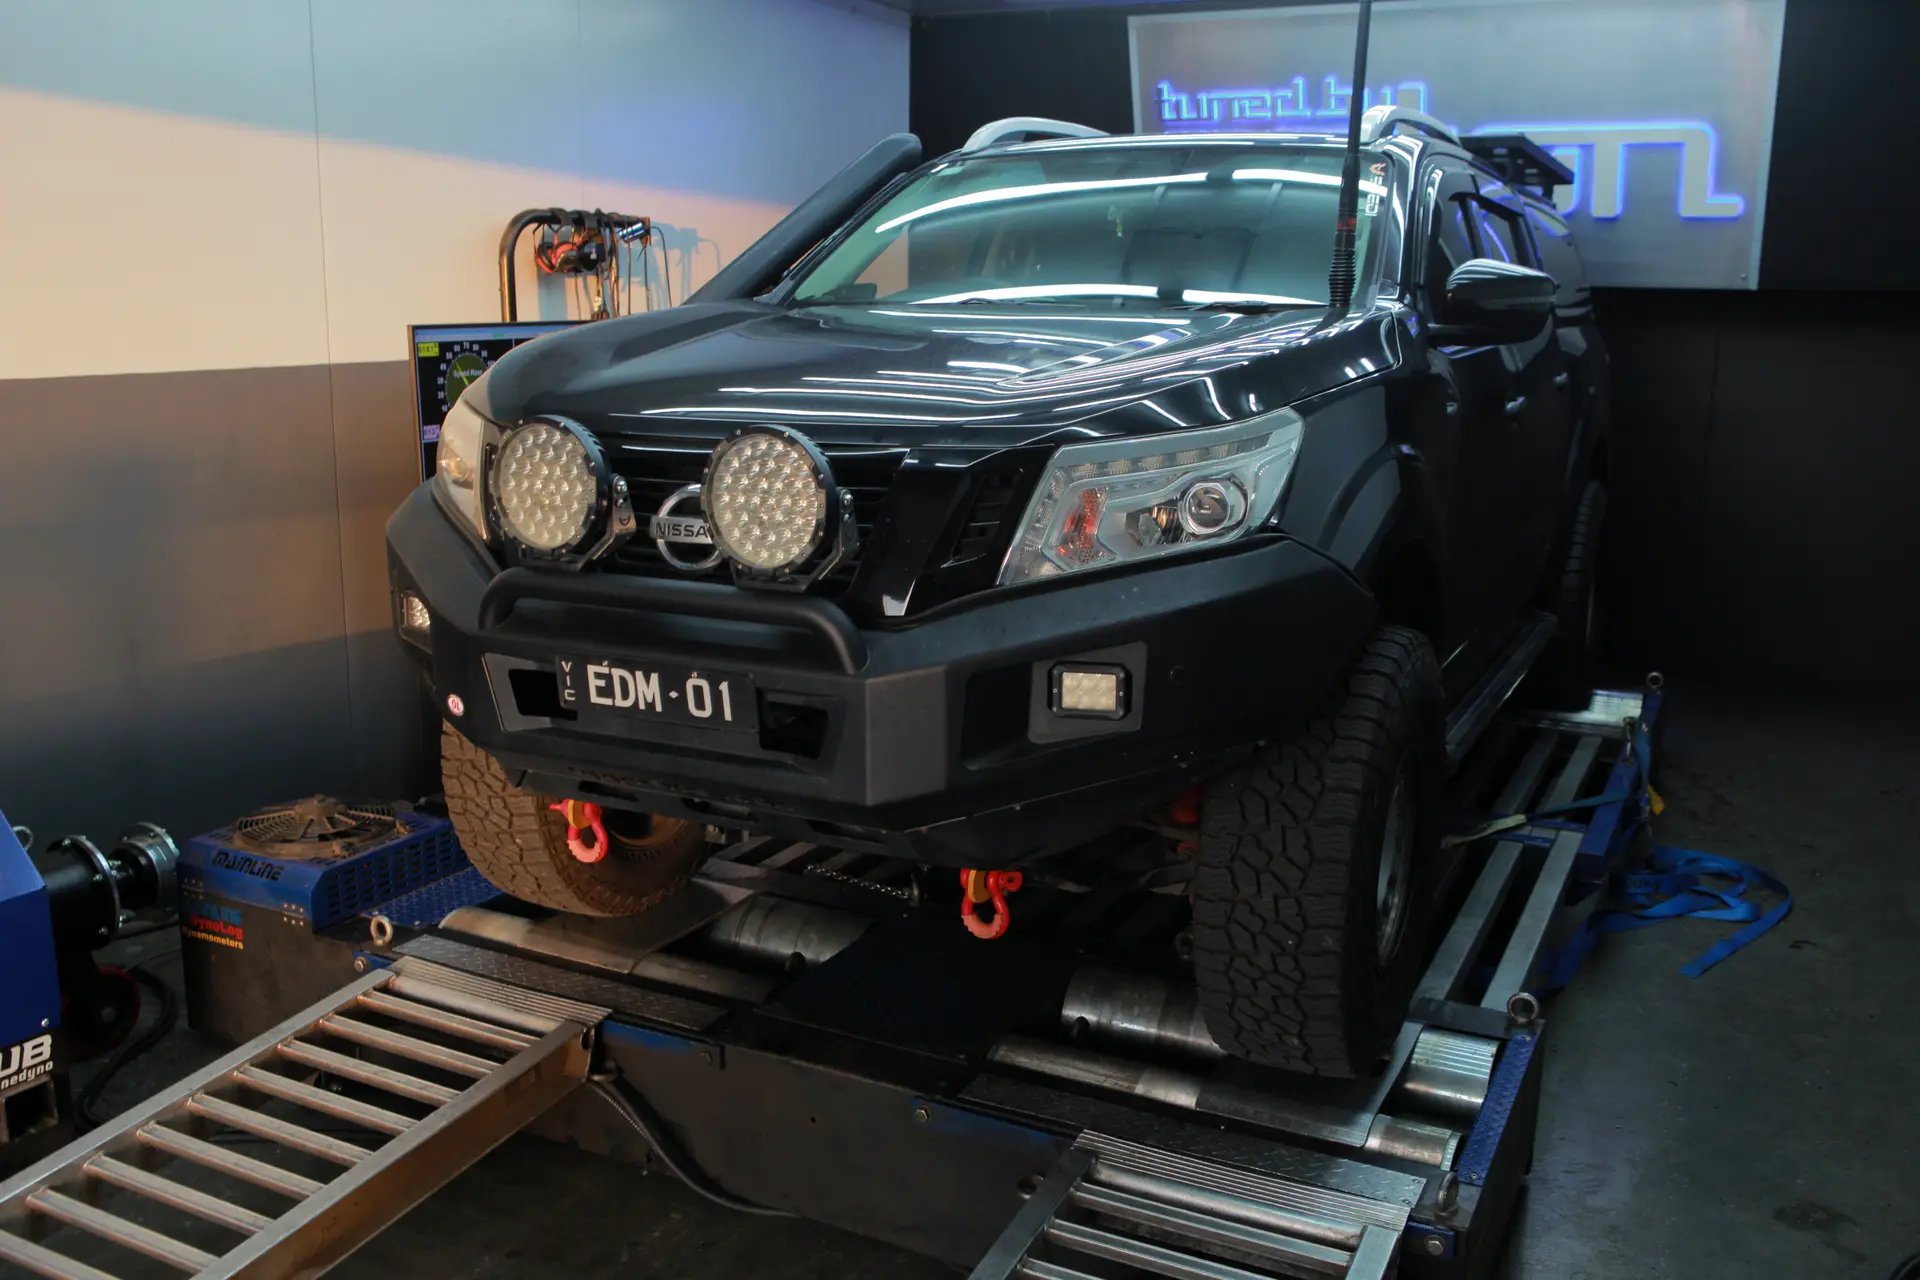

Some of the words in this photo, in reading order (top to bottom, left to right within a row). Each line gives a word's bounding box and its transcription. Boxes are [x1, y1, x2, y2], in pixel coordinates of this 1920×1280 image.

[1156, 77, 1311, 119] tuned
[655, 521, 709, 538] NISSA
[561, 660, 577, 701] VIC
